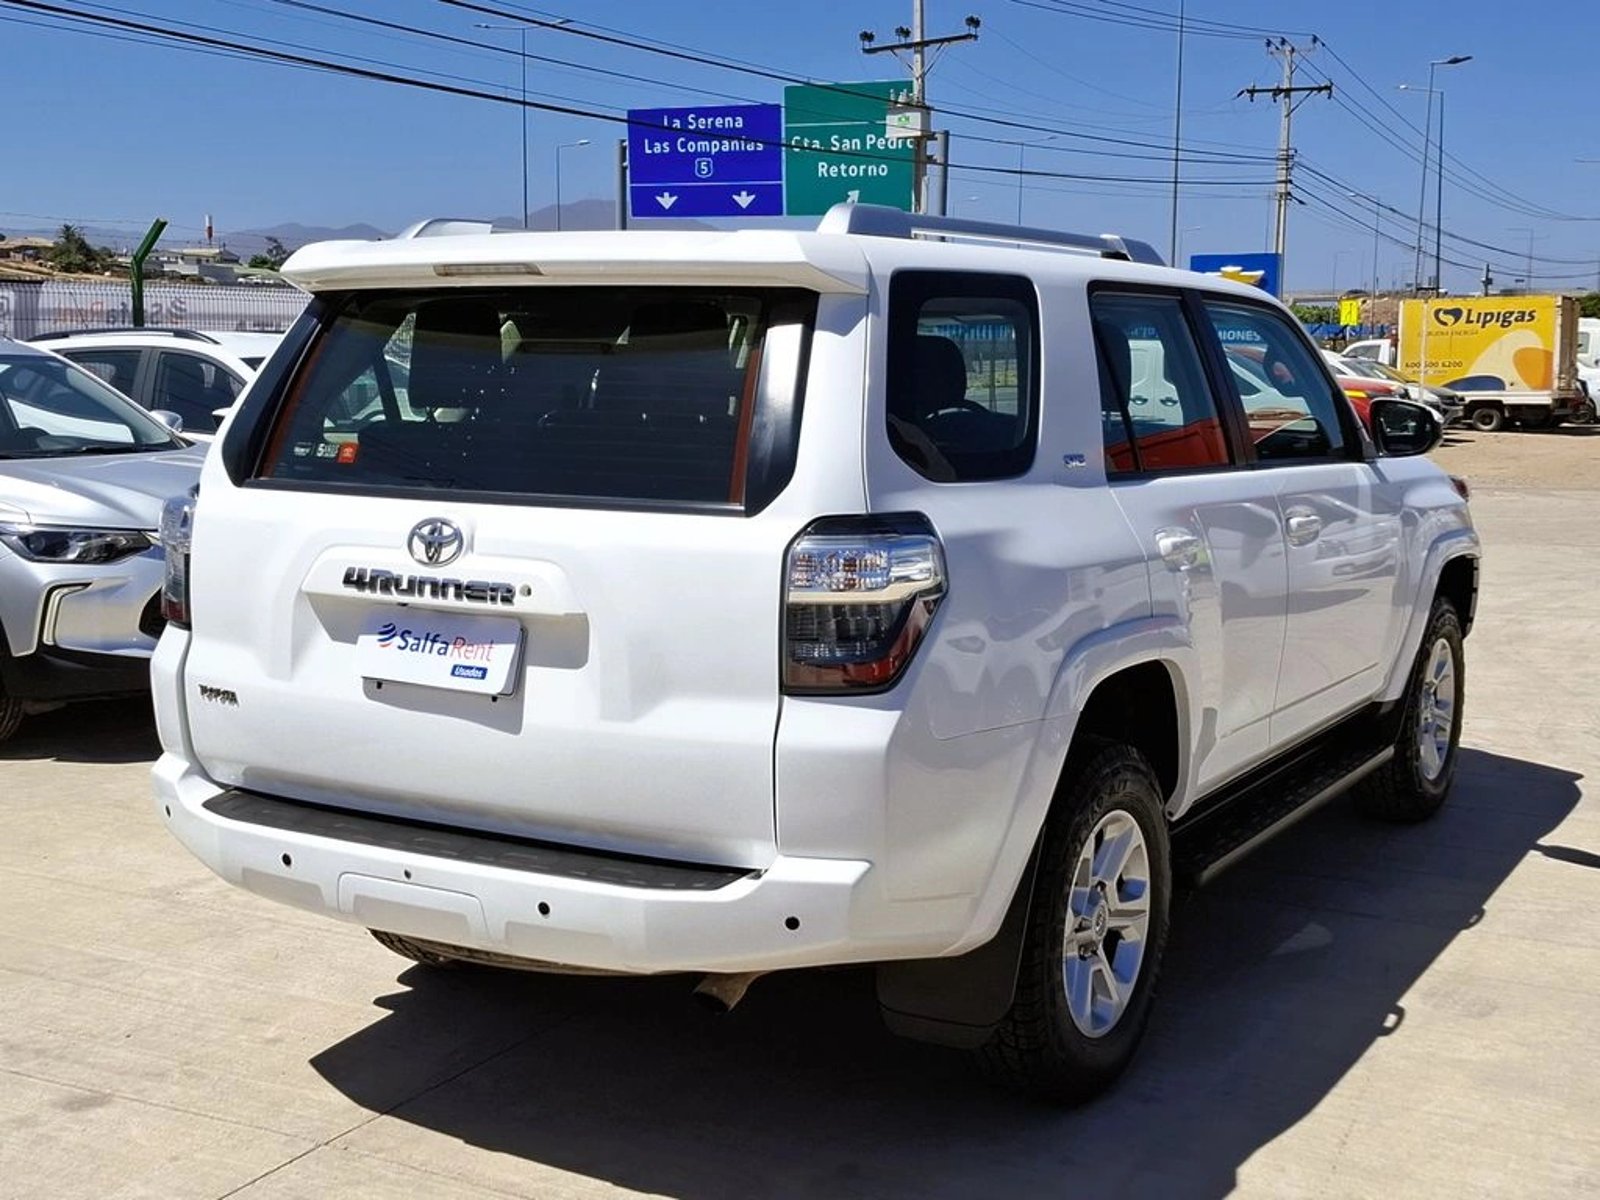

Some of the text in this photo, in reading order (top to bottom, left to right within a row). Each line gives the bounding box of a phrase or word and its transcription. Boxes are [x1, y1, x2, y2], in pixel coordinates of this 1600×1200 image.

[688, 113, 743, 129] Serena
[644, 138, 670, 154] Las
[830, 134, 861, 151] San
[700, 161, 708, 174] 5
[818, 161, 888, 178] Retorno
[1465, 308, 1537, 329] Lipigas
[397, 629, 494, 662] SalfaRent
